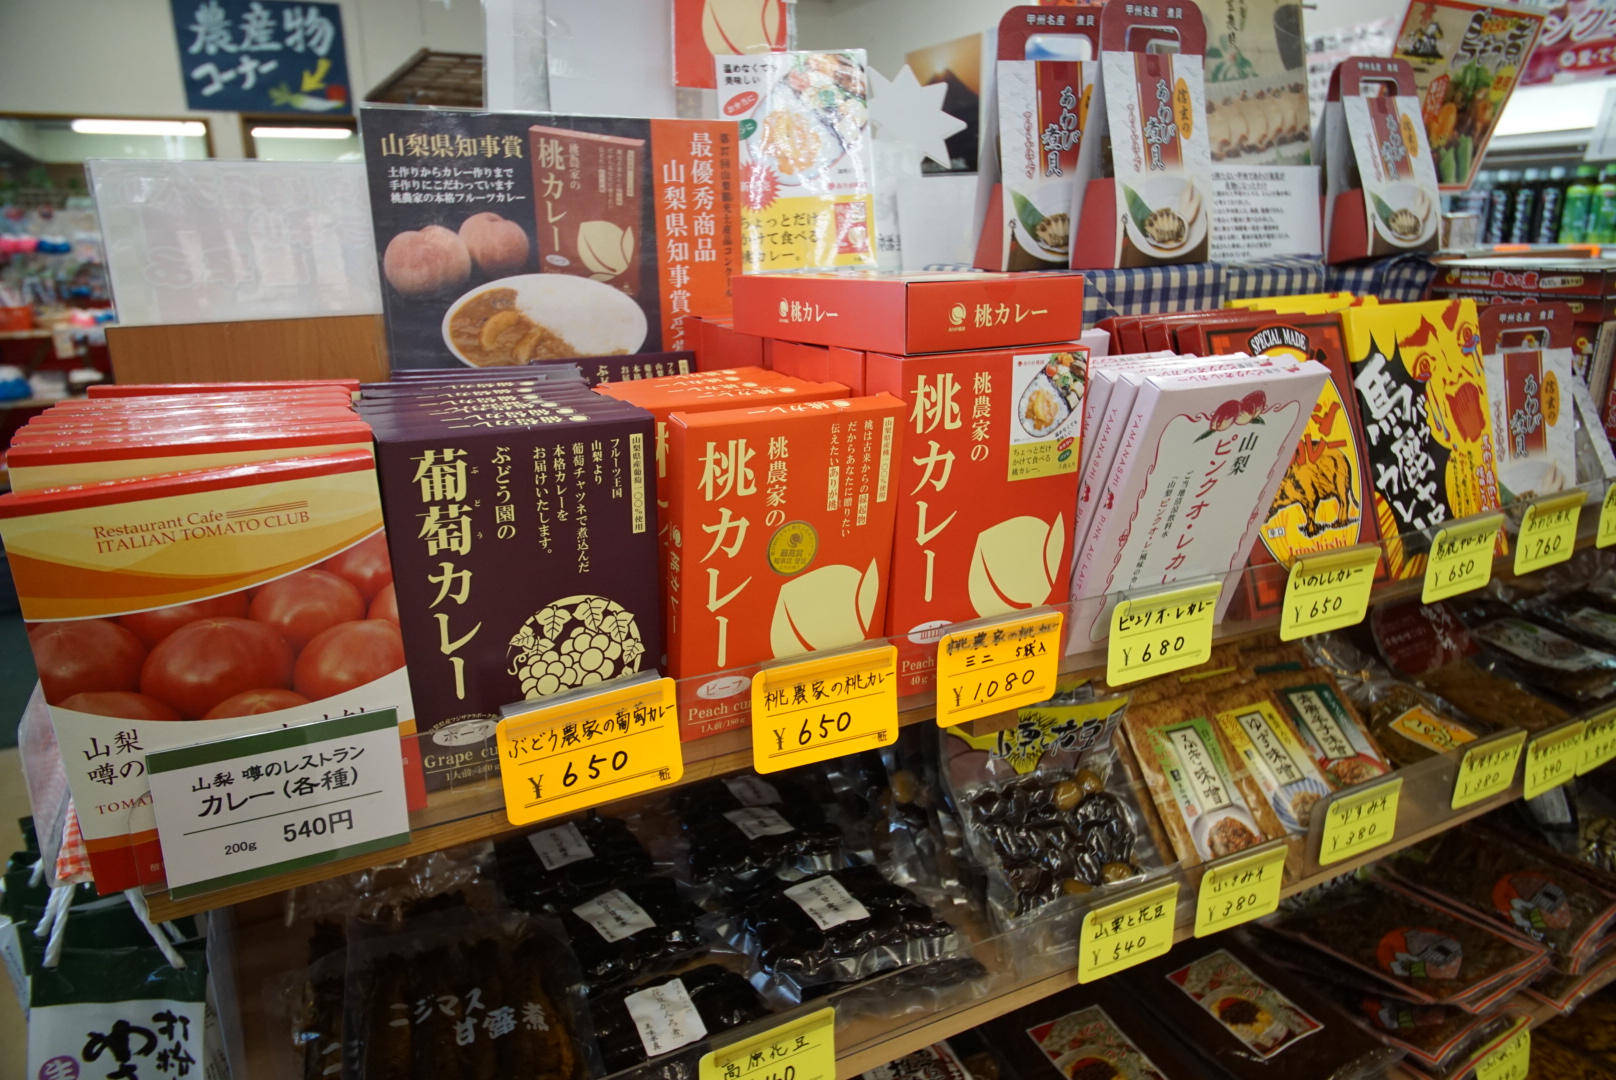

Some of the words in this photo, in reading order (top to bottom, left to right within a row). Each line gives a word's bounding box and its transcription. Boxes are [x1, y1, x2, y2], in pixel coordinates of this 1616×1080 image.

[188, 1, 335, 56] 農産物
[1026, 14, 1067, 26] 甲州名産
[1076, 15, 1096, 26] 煮貝
[1125, 4, 1160, 18] 甲州名産
[191, 56, 278, 96] コーナー
[381, 133, 523, 159] 山梨県知事賞
[388, 166, 514, 178] 土作りからカレー作りまで
[388, 180, 515, 191] 手作りにこだわっています
[390, 192, 526, 204] 桃農家の本格フルーツカレー
[537, 137, 568, 252] 桃カレー
[690, 132, 717, 262] 最優秀商品
[791, 301, 838, 322] 桃カレー
[974, 301, 1048, 329] 桃カレー
[1250, 329, 1283, 353] SPECIAL
[1283, 329, 1307, 350] MADE
[970, 372, 992, 462] 桃農家の
[591, 440, 603, 485] 山梨より
[1089, 409, 1118, 480] YAMANASHI
[1113, 414, 1143, 487] YAMANASHI
[1227, 432, 1259, 477] 山梨
[552, 444, 569, 522] 本格カレーを
[610, 437, 623, 499] フルーツ王国
[766, 436, 789, 527] 桃農家の
[827, 423, 840, 510] 伝えたいありが桃
[841, 420, 857, 537] だからあなたに贈りたい
[491, 446, 516, 540] ぶどう園の
[532, 446, 552, 554] お届けいたします。
[909, 373, 963, 602] 桃カレー
[93, 515, 183, 540] Restaurant
[187, 510, 224, 526] Cafe
[572, 442, 590, 574] 葡萄チャツネで煮込んだ
[96, 529, 177, 554] ITALIAN
[180, 518, 260, 542] TOMATO
[263, 511, 310, 527] CLUB
[1092, 514, 1106, 541] PINK
[1268, 528, 1285, 538] 辛口
[698, 439, 757, 667] 桃カレー
[1086, 545, 1095, 561] AU
[1535, 535, 1561, 559] 760
[410, 448, 482, 700] 葡萄カレー
[1294, 567, 1364, 592] いのししカレー
[1448, 560, 1475, 582] 650
[1310, 597, 1342, 617] 650
[902, 656, 935, 673] Peach
[966, 655, 995, 667] ミニ
[1142, 637, 1185, 663] 680
[705, 680, 743, 696] ビーフ
[763, 671, 896, 712] 桃農家の桃カレー
[688, 701, 728, 721] Peach
[798, 711, 852, 746] 650
[82, 728, 143, 762] 山梨
[509, 702, 675, 759] ぶどう農家の葡萄カレー
[990, 718, 1103, 760] 山栗と花豆
[191, 769, 235, 793] 山梨
[242, 746, 365, 784] 噂のレストラン
[424, 750, 473, 769] Grape
[562, 750, 629, 788] 650
[95, 794, 153, 815] TOMAT
[197, 766, 360, 818] カレー(各種)
[224, 840, 258, 856] 200g
[283, 809, 354, 843] 540円
[1346, 823, 1377, 846] 380
[1095, 902, 1167, 940] 山栗と花豆
[1223, 893, 1257, 917] 380
[1113, 936, 1147, 960] 540
[389, 988, 485, 1027] ニジマス
[452, 1001, 550, 1047] 甘露煮
[722, 1035, 810, 1080] 高原花豆
